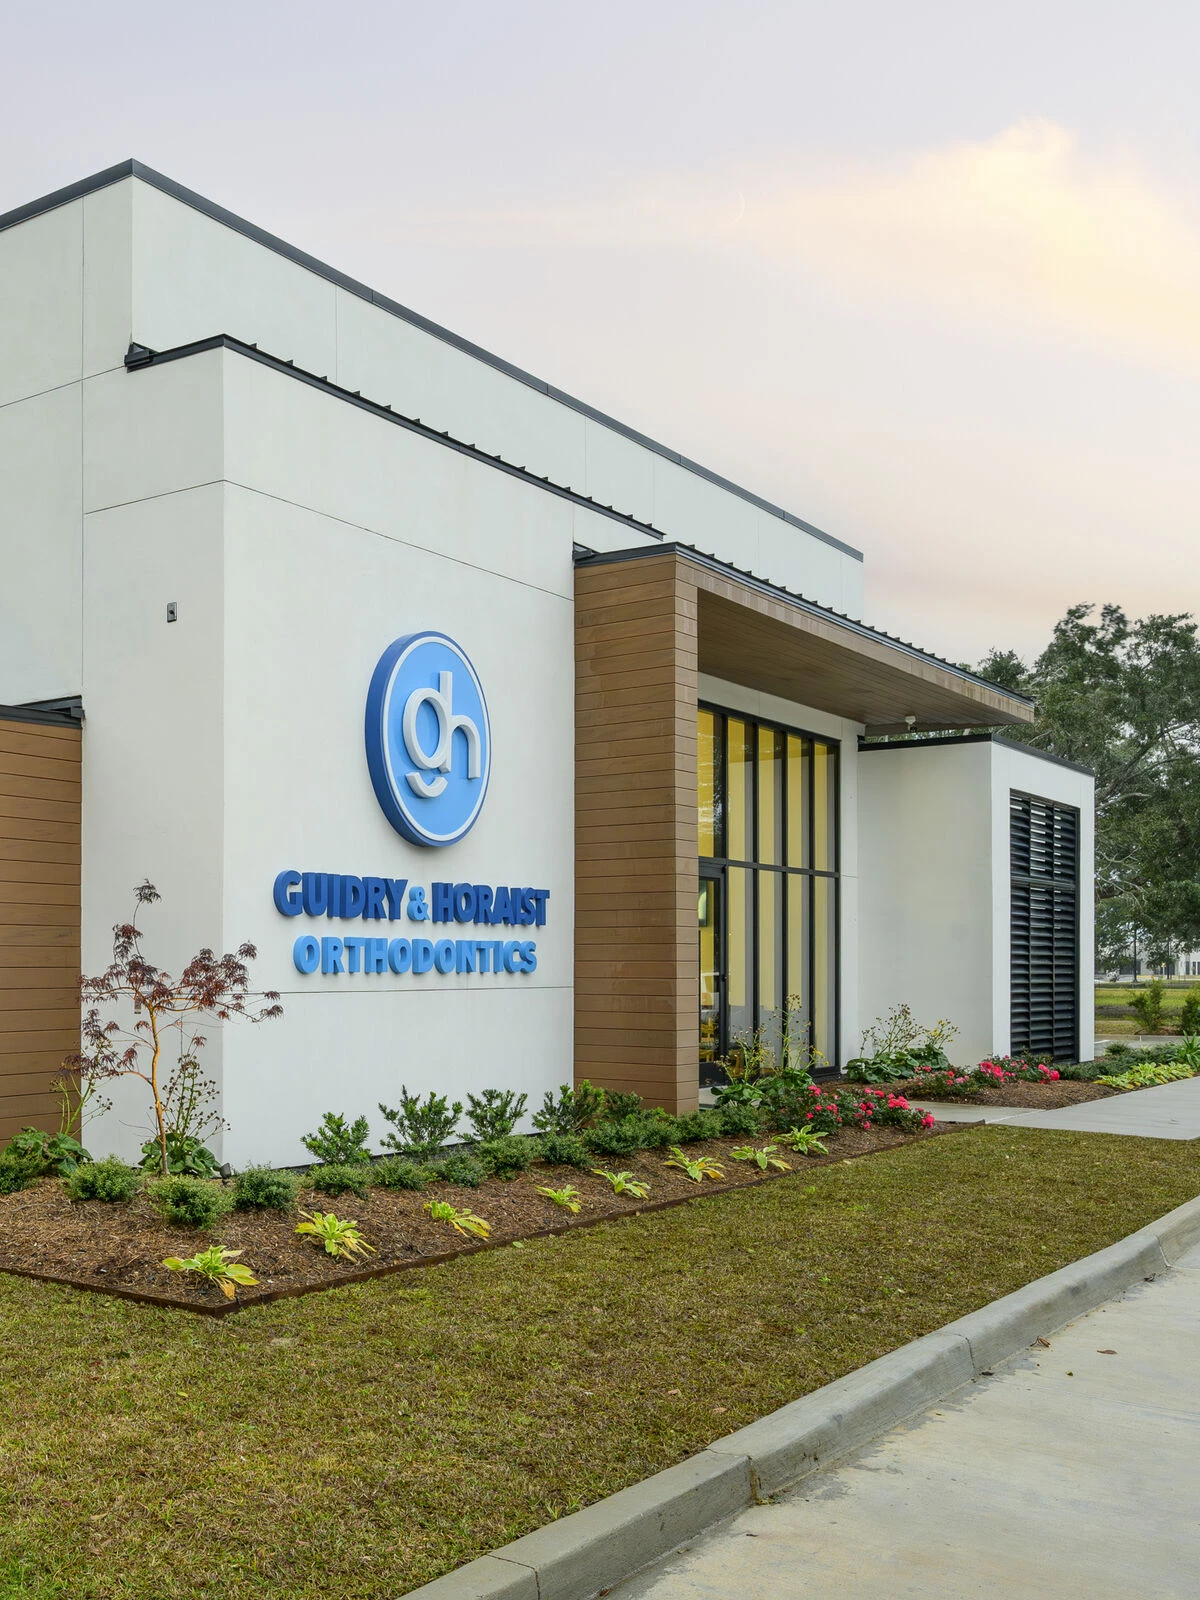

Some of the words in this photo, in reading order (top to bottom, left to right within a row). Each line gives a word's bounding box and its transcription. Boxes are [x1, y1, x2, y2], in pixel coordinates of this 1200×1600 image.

[273, 870, 408, 920] GUIDRY
[407, 886, 430, 921] &
[431, 882, 550, 926] HORAIST
[293, 935, 537, 974] ORTHODONTICS
